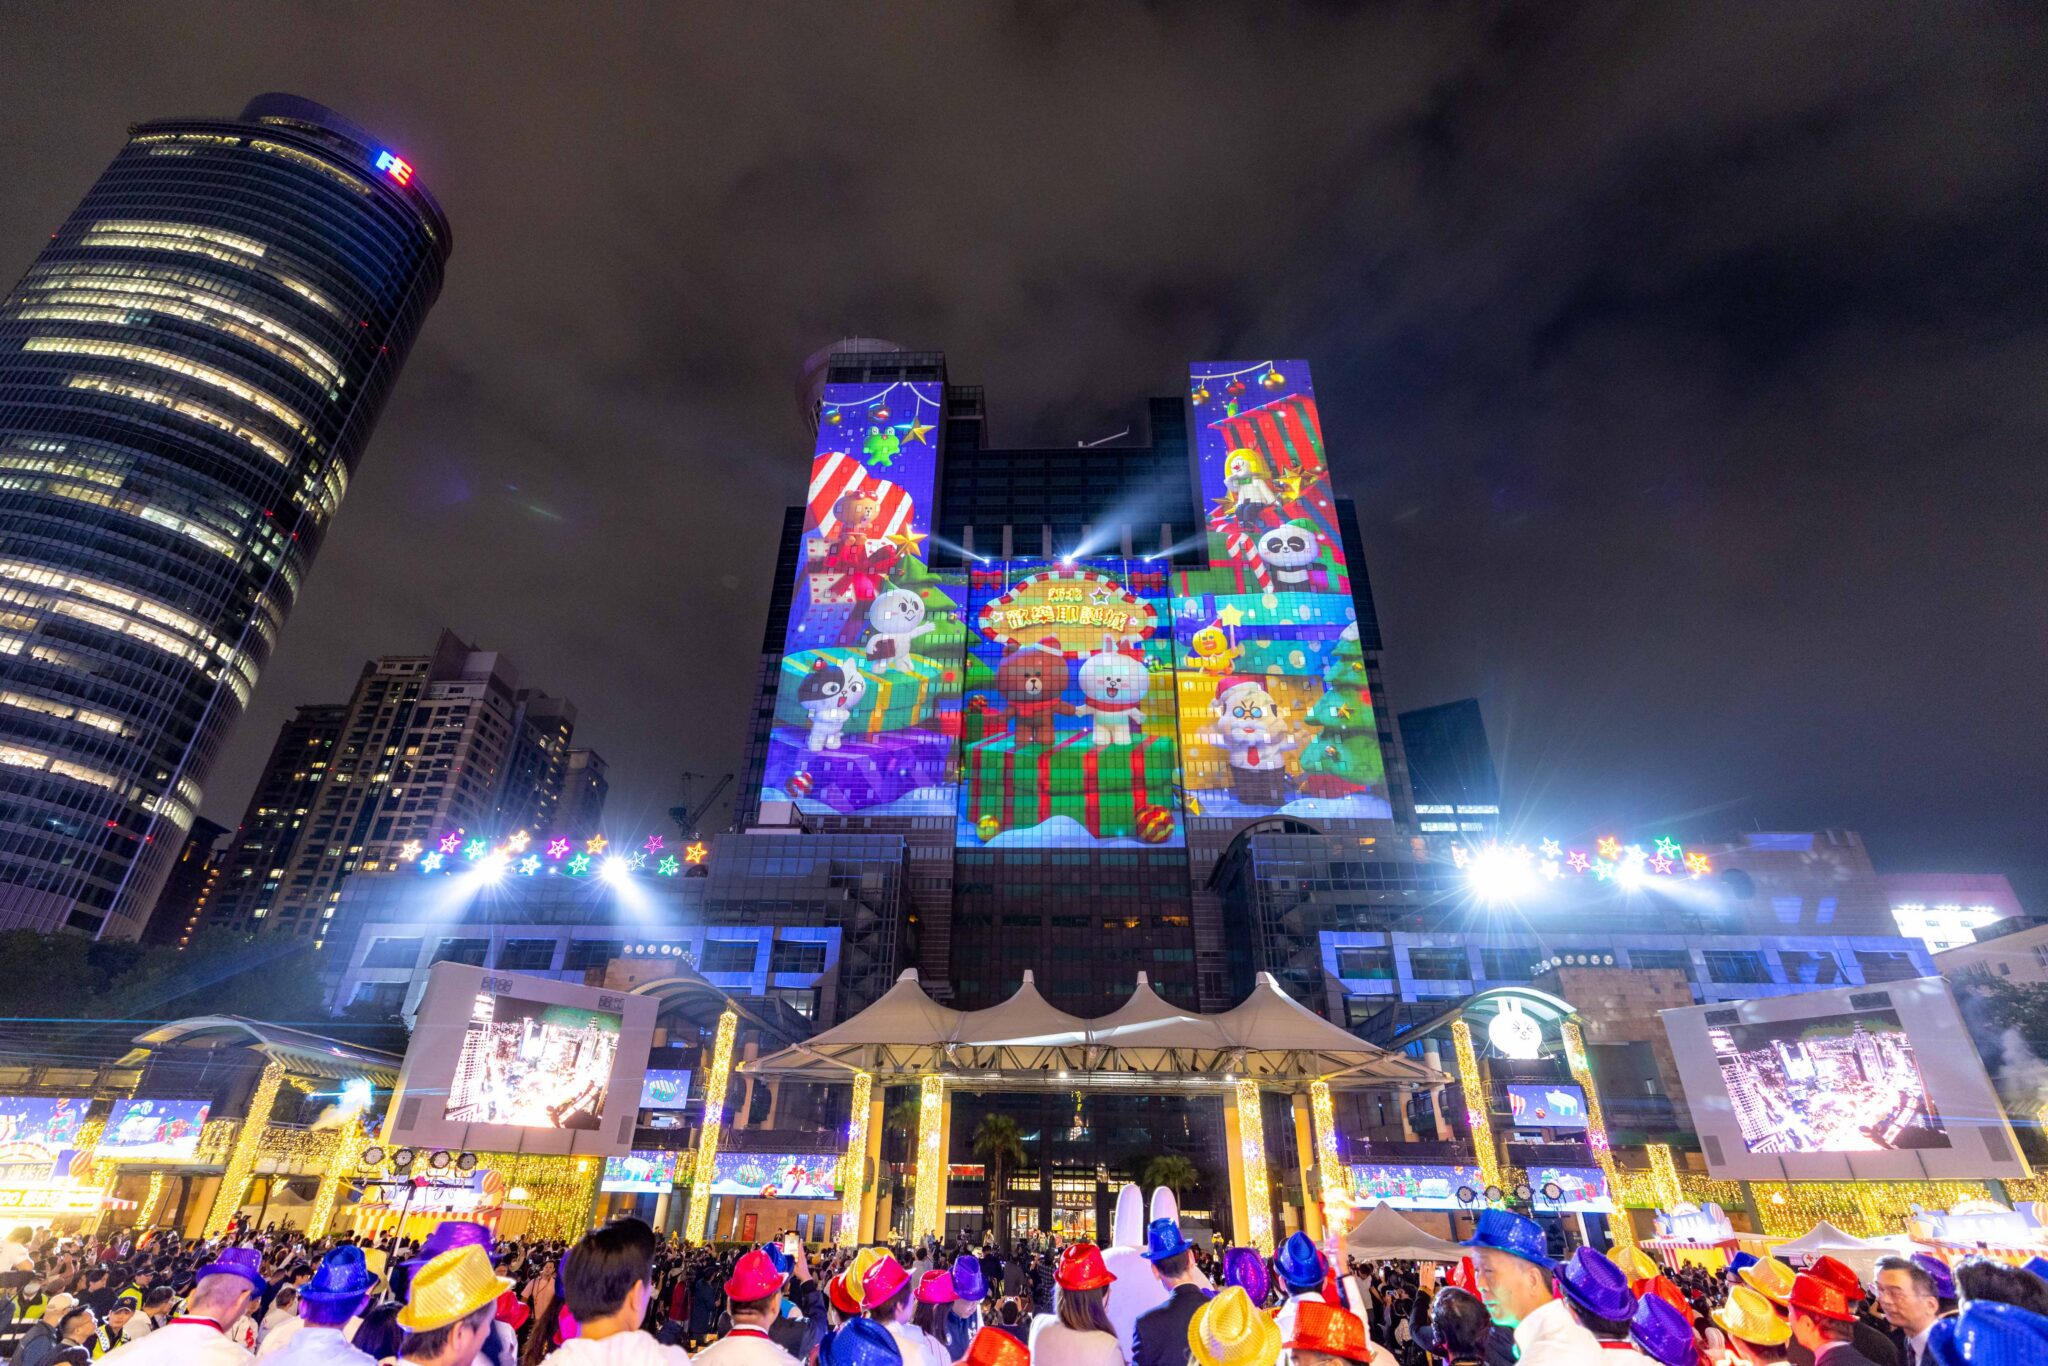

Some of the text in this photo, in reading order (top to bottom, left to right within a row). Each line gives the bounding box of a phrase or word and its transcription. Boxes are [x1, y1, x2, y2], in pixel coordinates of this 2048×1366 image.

[1048, 587, 1083, 602] 新北
[1006, 605, 1129, 632] 歡樂耶誕城
